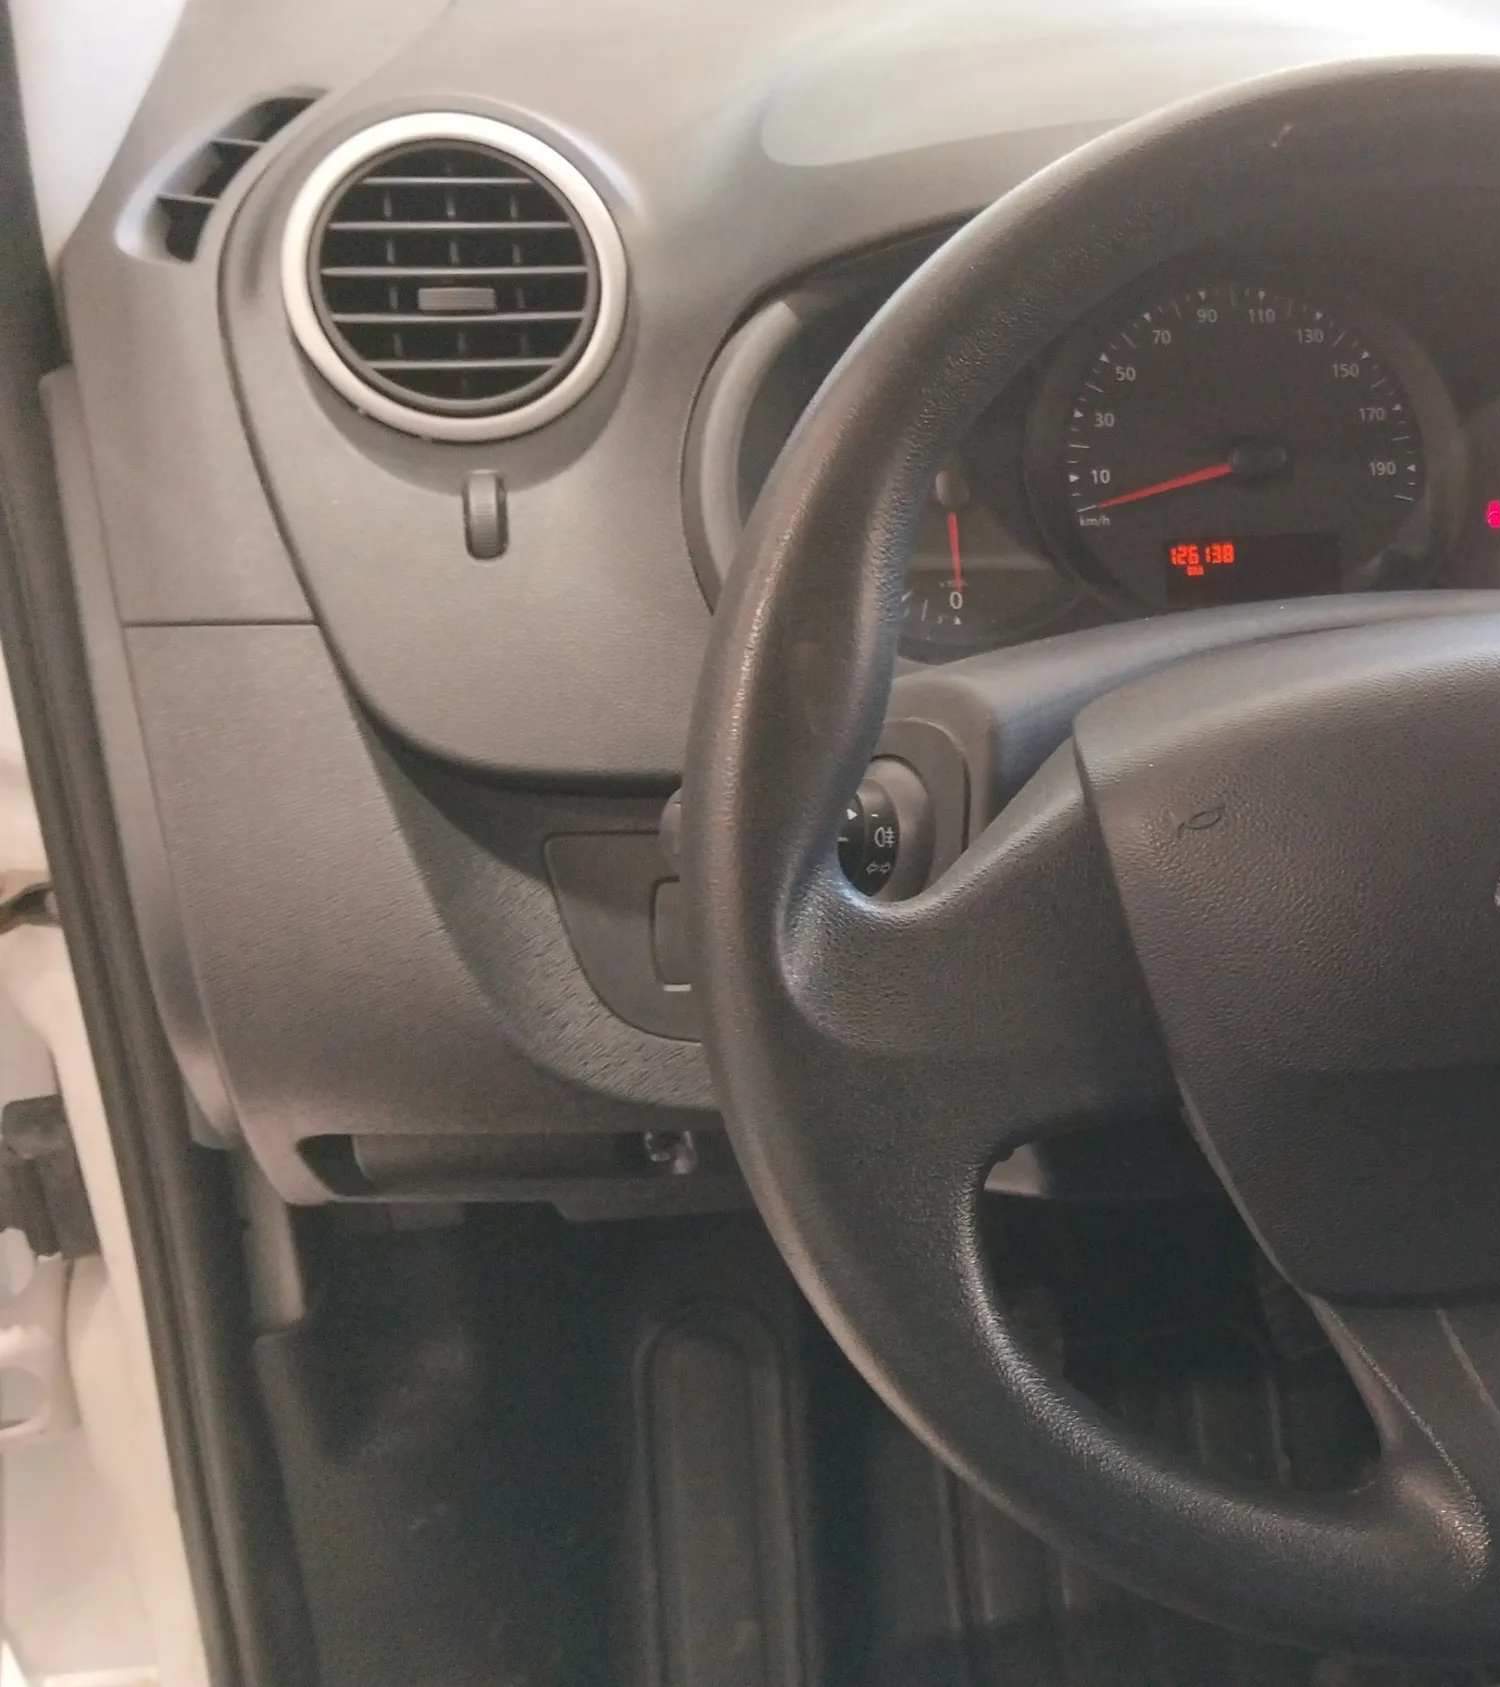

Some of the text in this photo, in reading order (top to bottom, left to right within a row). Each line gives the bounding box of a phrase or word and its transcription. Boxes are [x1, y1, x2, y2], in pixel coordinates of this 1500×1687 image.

[1197, 308, 1217, 323] 90
[1249, 308, 1276, 323] 110
[1152, 329, 1172, 345] 70
[1297, 328, 1324, 344] 130
[1115, 366, 1136, 381] 50
[1332, 363, 1360, 378] 150
[1094, 412, 1115, 428] 30
[1359, 406, 1385, 421] 170
[1369, 461, 1396, 476] 190
[1091, 469, 1111, 484] 10
[1079, 514, 1110, 527] km/h
